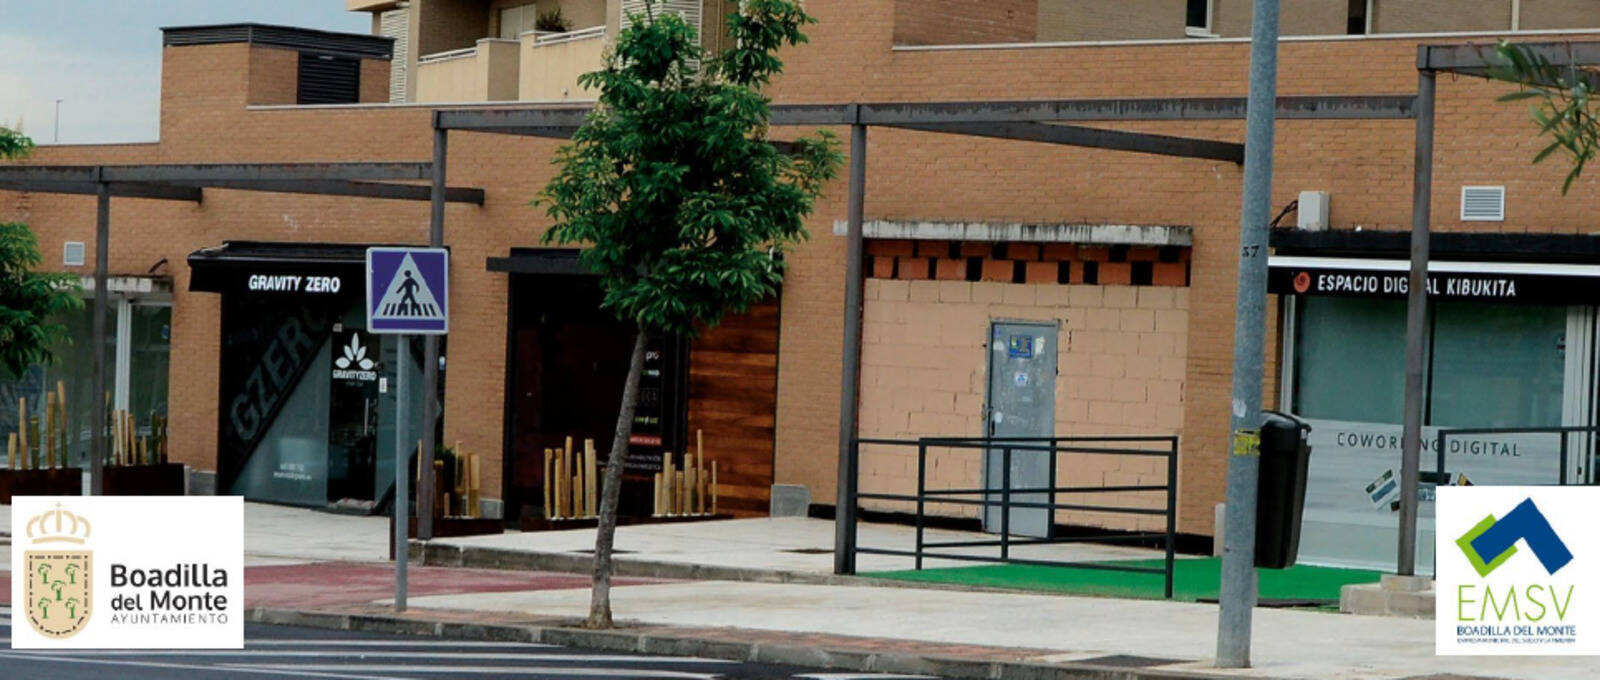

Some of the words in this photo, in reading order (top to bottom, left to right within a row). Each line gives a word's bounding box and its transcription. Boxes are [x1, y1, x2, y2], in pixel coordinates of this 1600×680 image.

[248, 274, 302, 291] GRAVITY
[305, 276, 341, 293] ZERO
[1318, 274, 1378, 293] ESPACIO
[1383, 276, 1440, 294] DIGAL
[1446, 279, 1516, 297] KIBUKITA
[1337, 432, 1440, 452] COWORNG
[1450, 440, 1521, 457] DIGITAL
